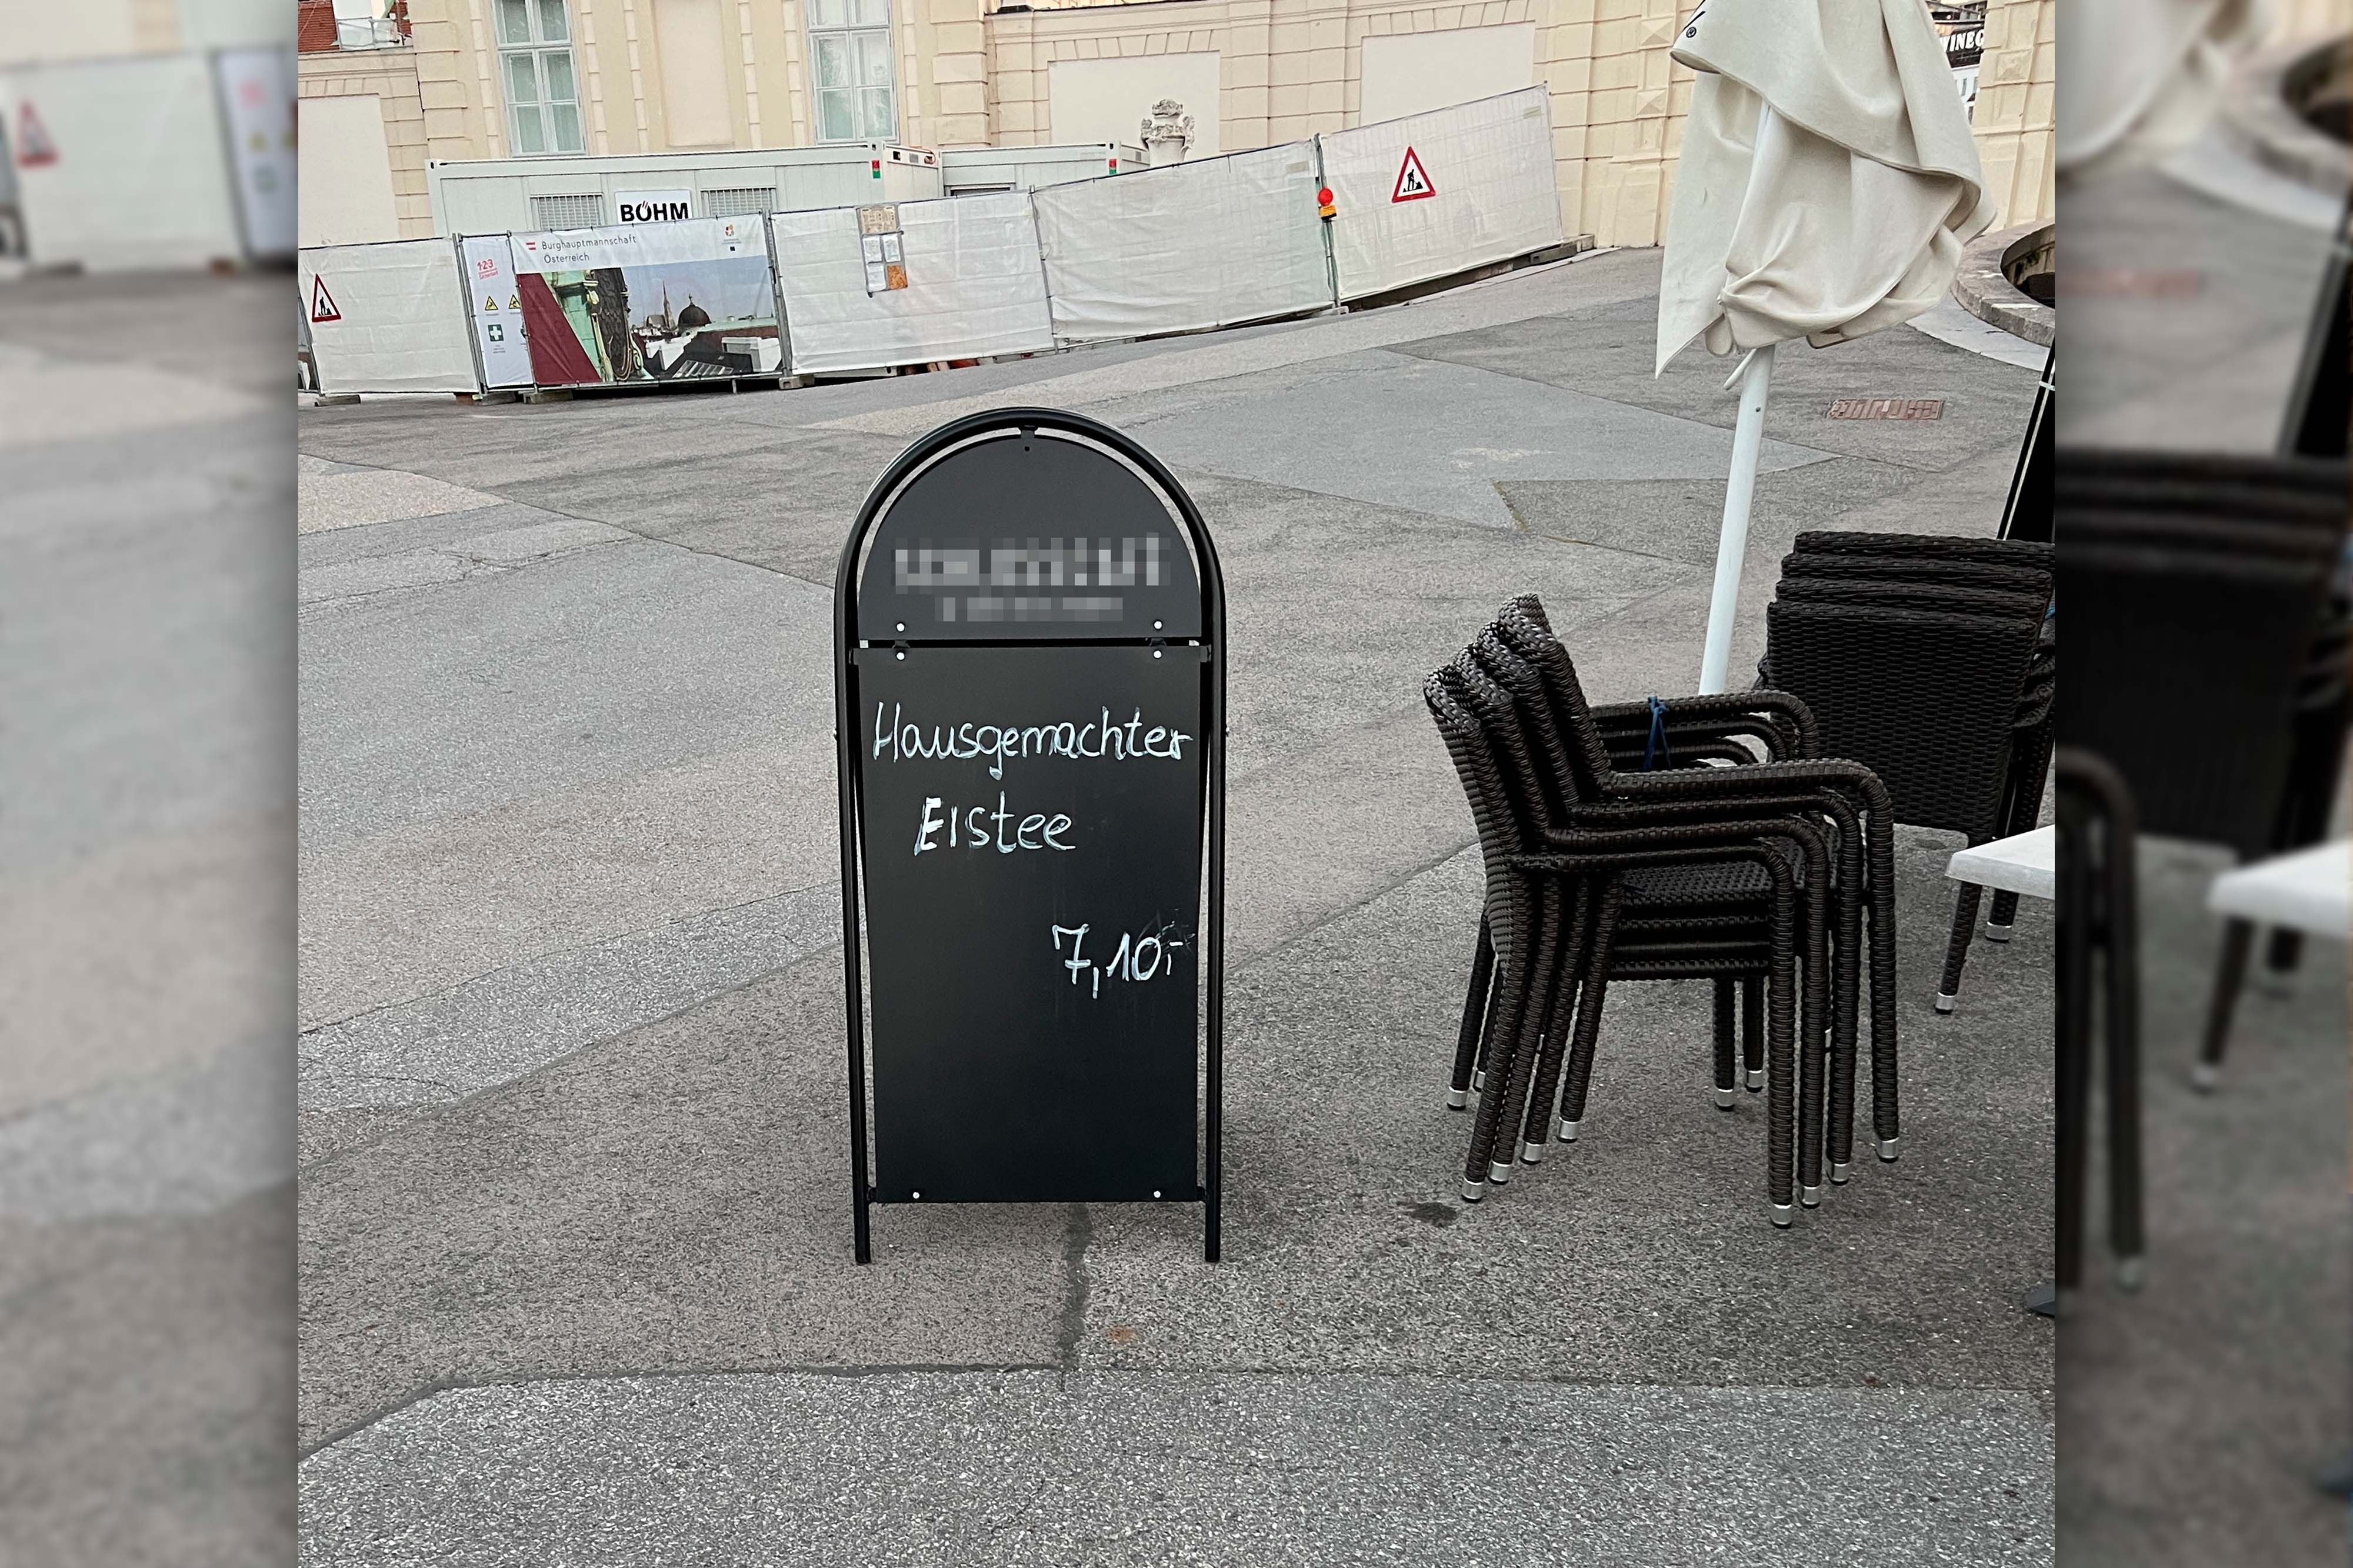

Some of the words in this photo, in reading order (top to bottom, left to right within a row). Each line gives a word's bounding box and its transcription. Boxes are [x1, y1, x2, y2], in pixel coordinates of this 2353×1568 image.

[621, 201, 688, 222] BÖHM
[542, 234, 636, 251] Burghauptmannschaft
[544, 252, 590, 263] Österreich
[874, 702, 1194, 780] Hausgemachter
